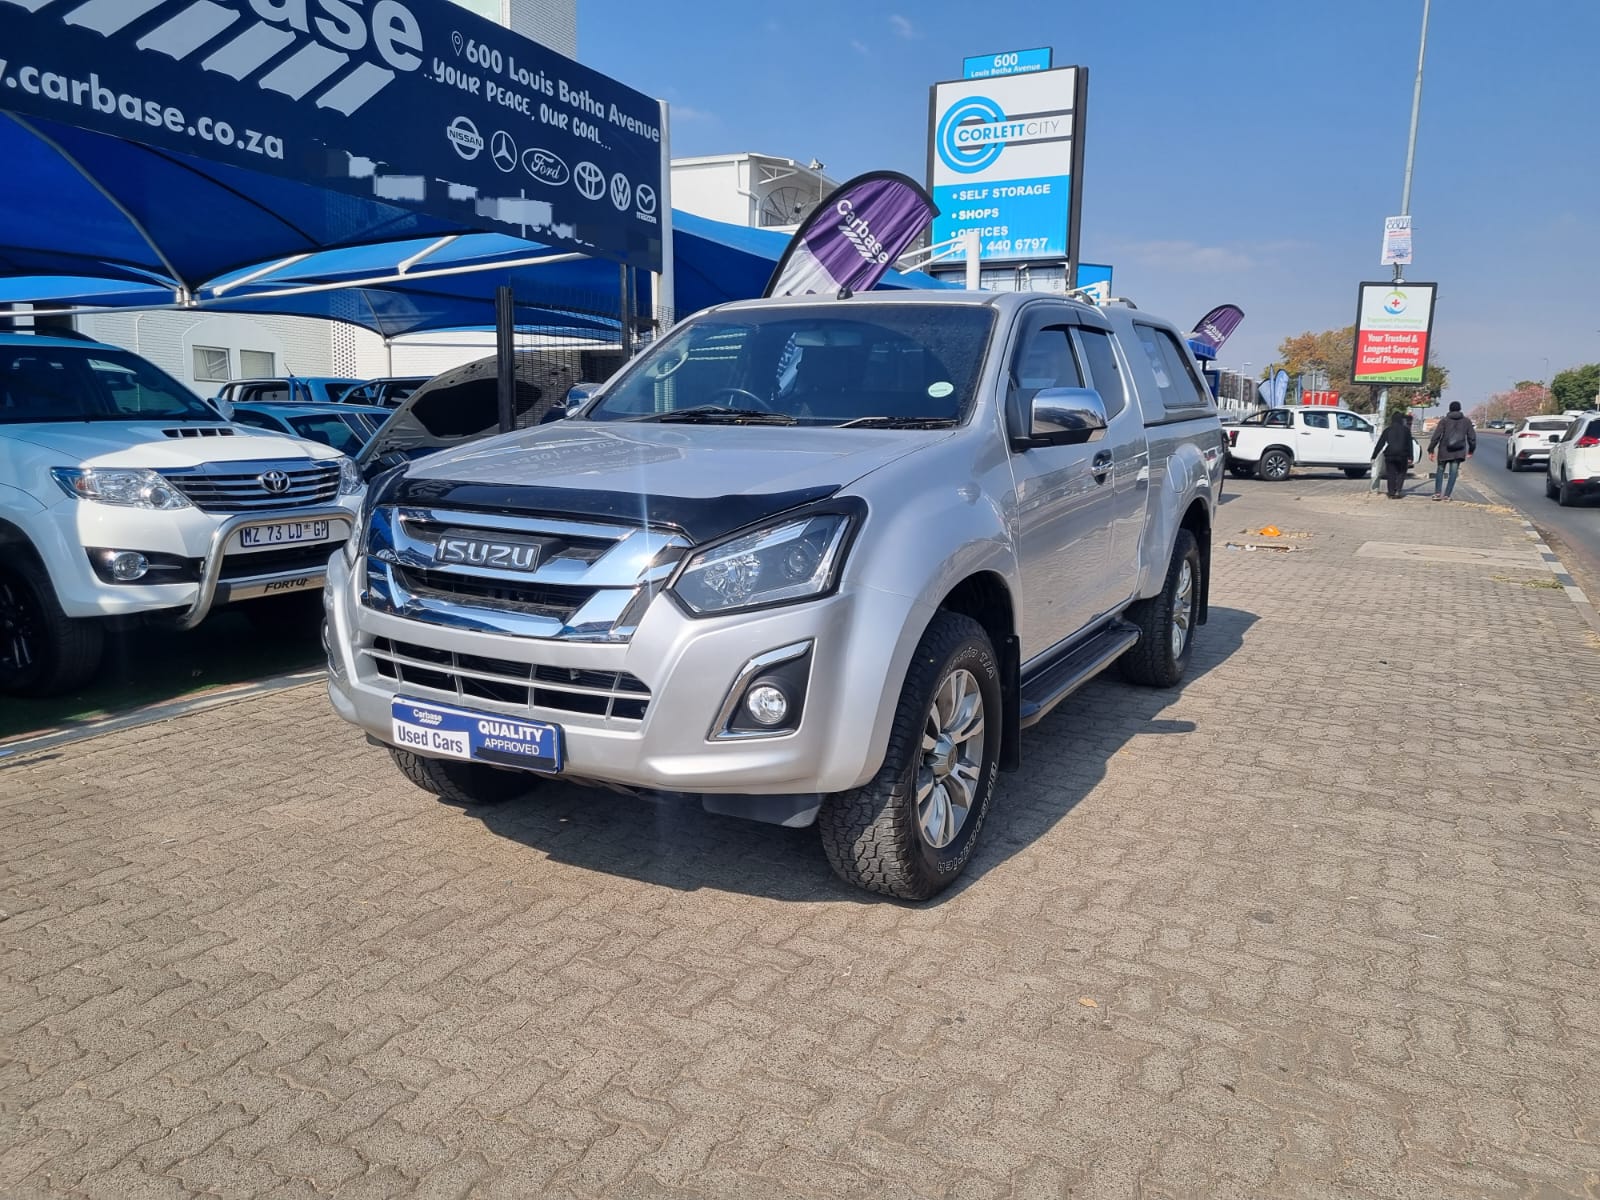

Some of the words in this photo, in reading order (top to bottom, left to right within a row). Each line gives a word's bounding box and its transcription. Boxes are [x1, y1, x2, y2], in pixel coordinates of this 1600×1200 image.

[994, 53, 1019, 68] 600
[970, 69, 990, 78] Louis
[991, 66, 1012, 75] Botha
[1013, 64, 1041, 73] Avenue
[466, 39, 502, 74] 600
[509, 57, 554, 96] Louis
[559, 80, 605, 119] Botha
[609, 103, 660, 143] Avenue
[0, 59, 285, 160] .carbase.co.za
[540, 103, 568, 131] OUR
[449, 129, 484, 150] NISSAN
[530, 152, 561, 179] Ford
[959, 186, 989, 201] SELF
[992, 184, 1051, 198] STORAGE
[958, 207, 999, 220] SHOPS
[836, 199, 889, 264] Carbase
[958, 226, 1009, 239] OICES
[986, 239, 1011, 251] 440
[1014, 237, 1049, 250] 6797
[1367, 333, 1384, 342] Your
[1384, 334, 1411, 343] Trusted
[1363, 344, 1392, 354] Longest
[1392, 345, 1420, 355] Serving
[1363, 355, 1382, 364] Local
[1382, 356, 1418, 367] Pharmacy
[244, 527, 260, 543] MZ
[267, 525, 282, 541] 73
[288, 523, 302, 540] LD
[313, 520, 326, 537] GP
[438, 538, 537, 568] ISUZU
[413, 708, 443, 723] Carbase
[398, 724, 428, 747] Used
[433, 732, 464, 753] Cars
[478, 721, 544, 742] QUALITY
[484, 739, 541, 755] APPROVED
